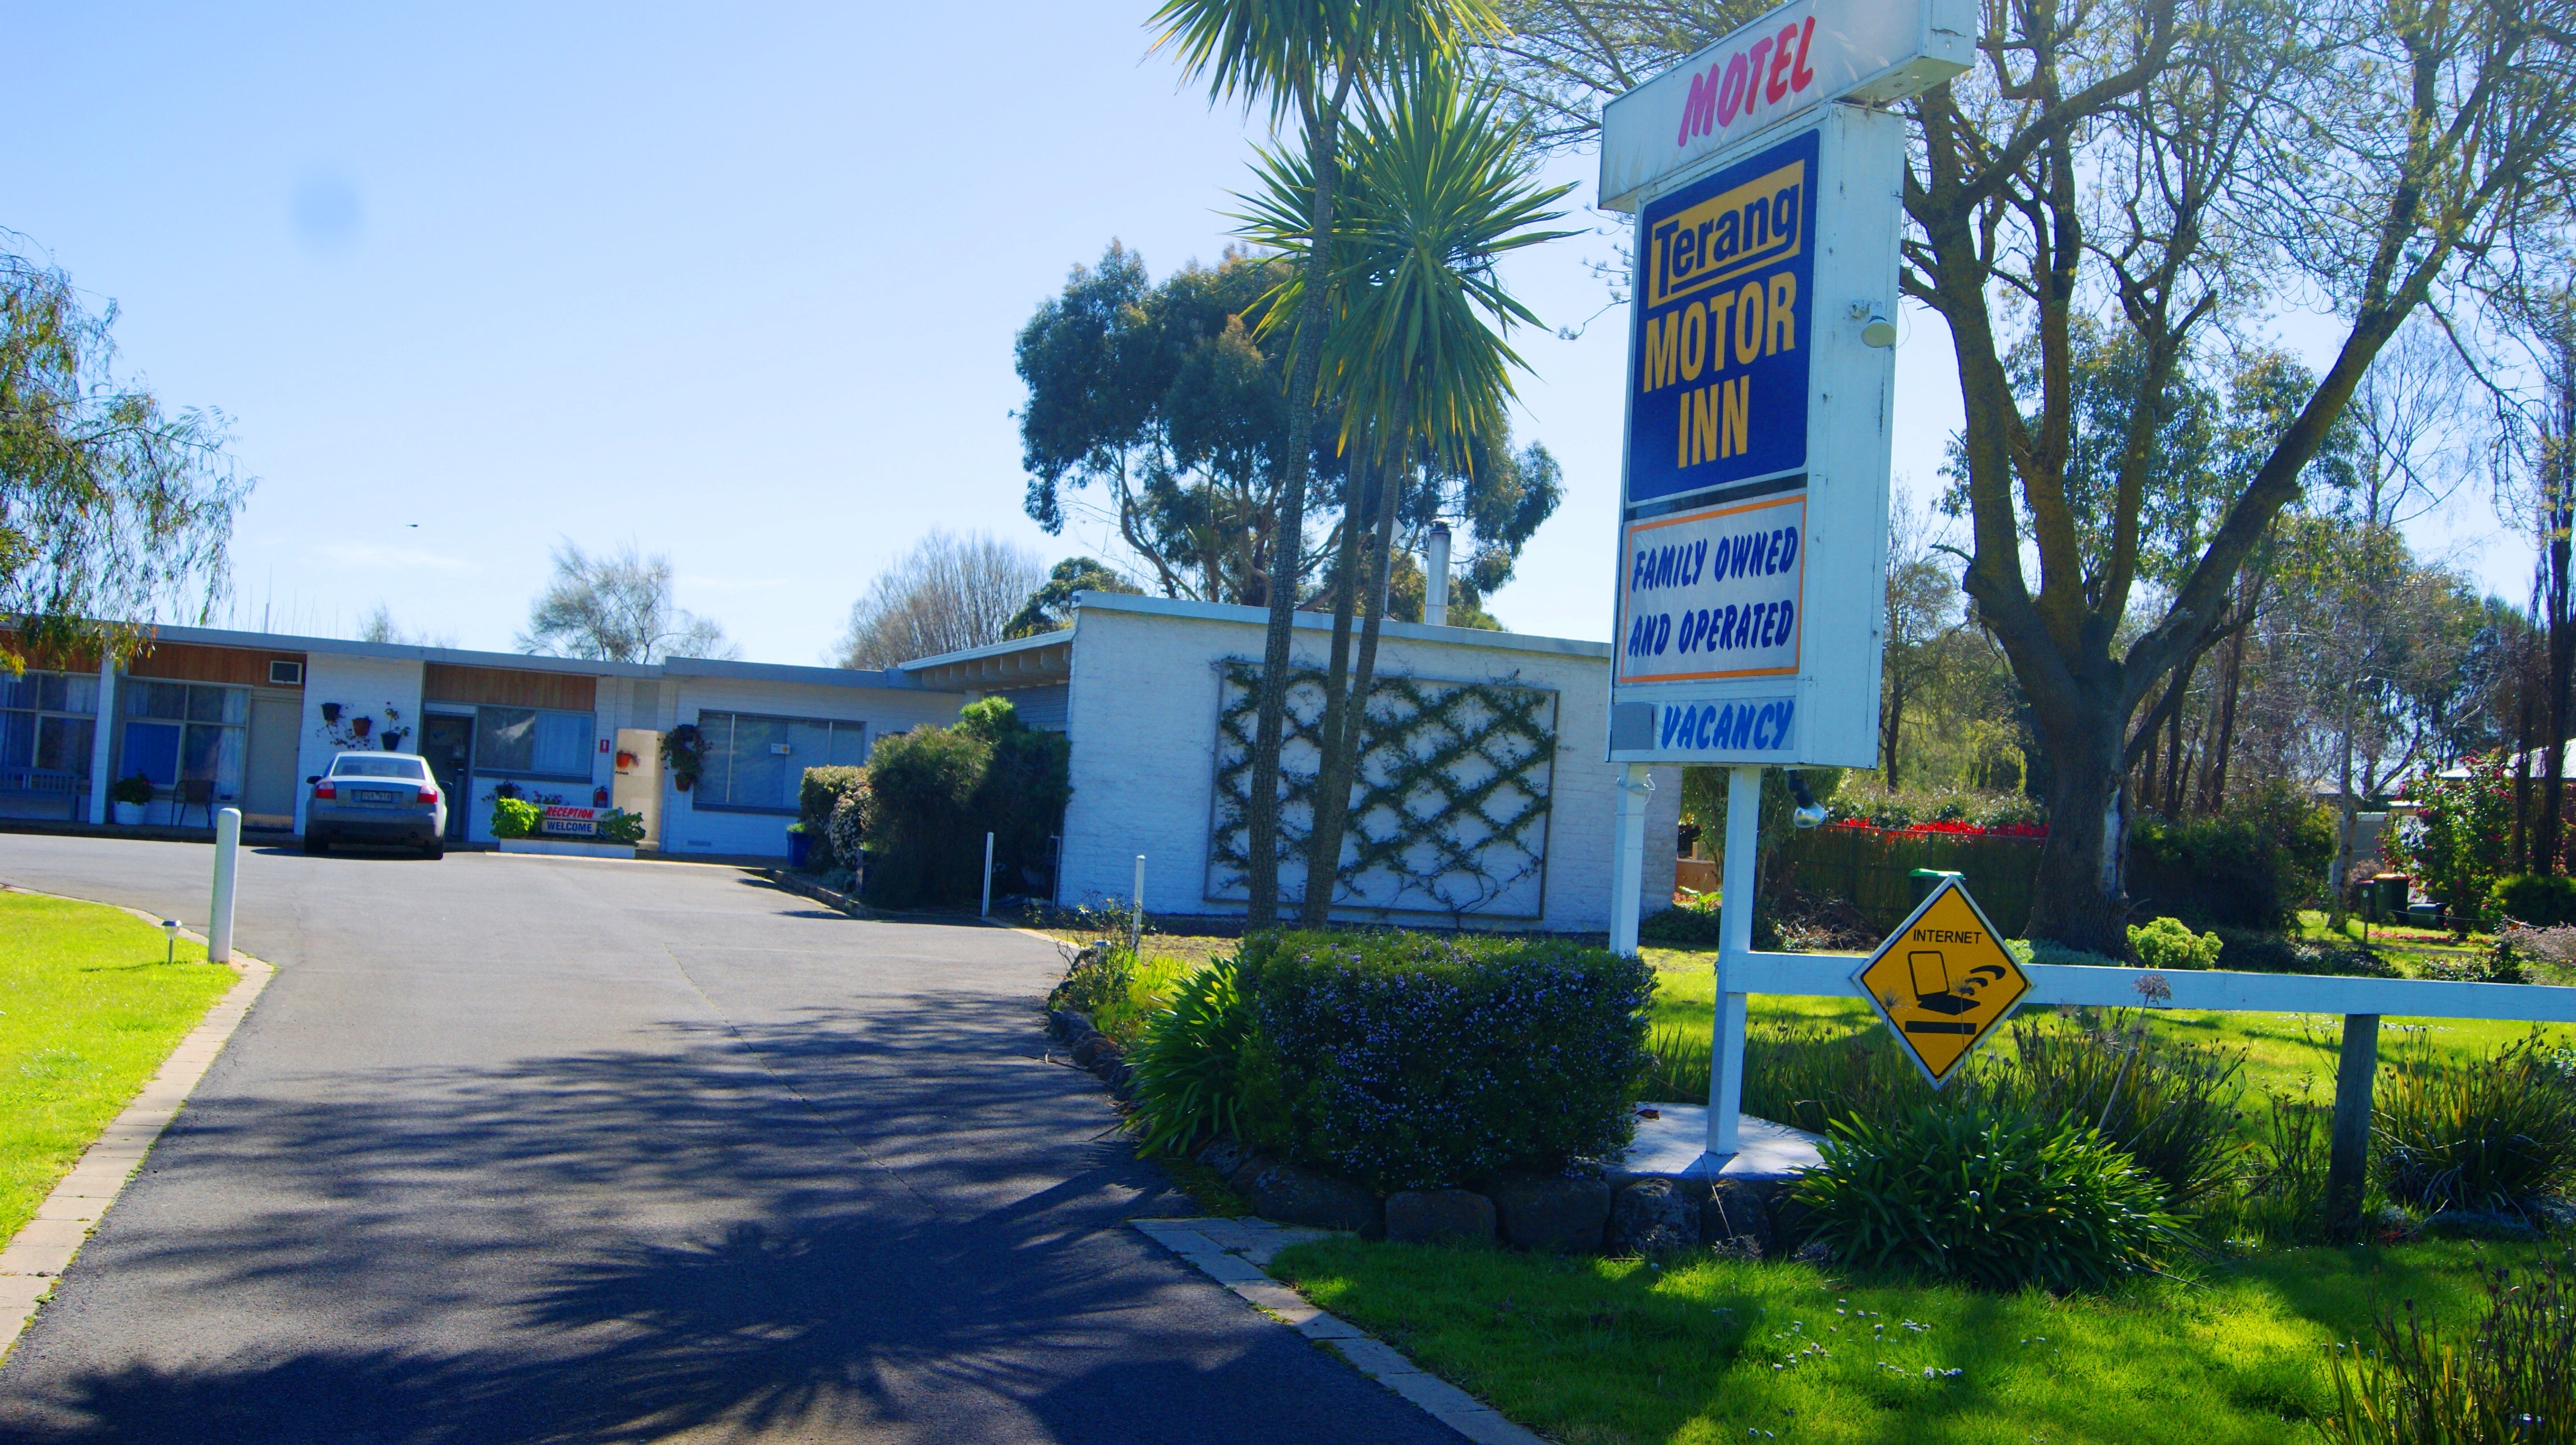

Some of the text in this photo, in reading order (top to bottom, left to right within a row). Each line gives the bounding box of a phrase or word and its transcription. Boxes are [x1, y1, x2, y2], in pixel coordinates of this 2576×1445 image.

[1678, 15, 1815, 147] MOTEL
[1654, 183, 1800, 299] Terang
[1643, 271, 1797, 393] MOTOR
[1678, 375, 1749, 468] INN
[1632, 526, 1798, 593] FAMILY OWNED
[1629, 600, 1794, 657] AND OPERATED
[1661, 700, 1794, 749] VACANCY
[546, 806, 594, 818] RECEPTION
[547, 821, 592, 832] WELCOME
[1913, 929, 1981, 944] INTERNET
